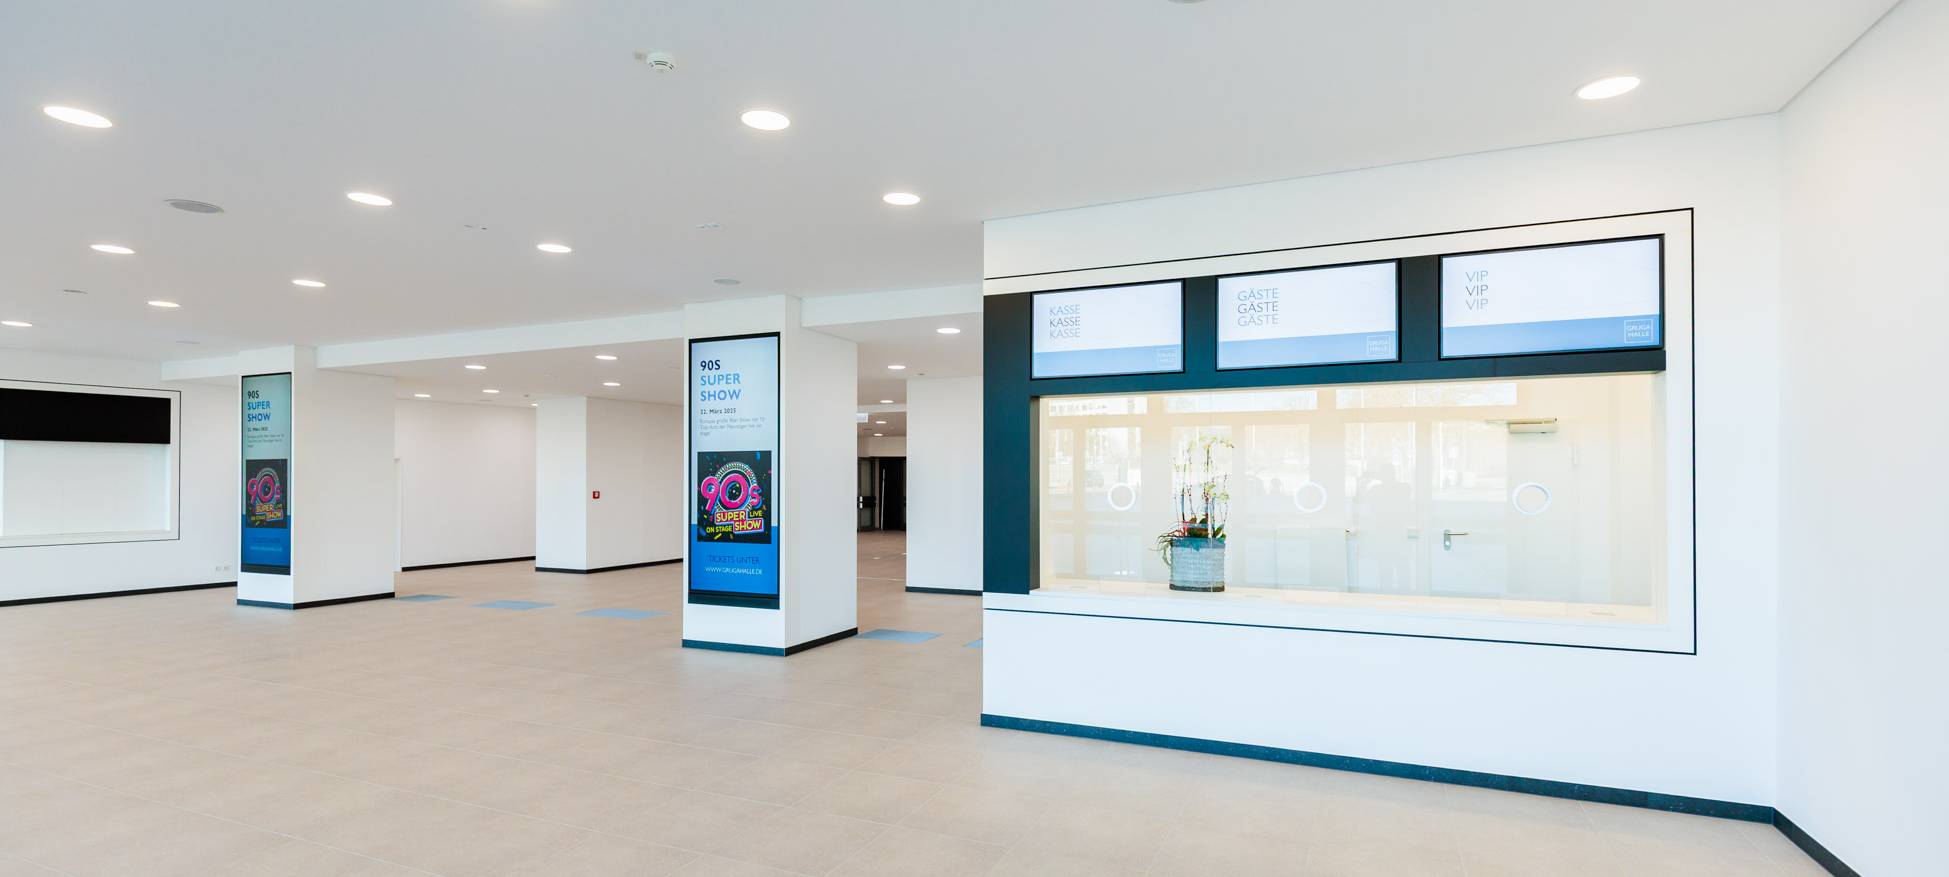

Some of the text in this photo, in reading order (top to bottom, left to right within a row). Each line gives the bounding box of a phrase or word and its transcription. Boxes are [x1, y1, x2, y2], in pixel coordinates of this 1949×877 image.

[1465, 270, 1489, 282] VIP
[1237, 287, 1279, 301] GÄSTE
[1465, 285, 1489, 296] VIP
[1049, 304, 1080, 316] KASSE
[1237, 301, 1279, 314] GÄSTE
[1465, 298, 1489, 310] VIP
[1049, 316, 1080, 327] KASSE
[1237, 313, 1279, 327] GÄSTE
[1049, 327, 1080, 339] KASSE
[700, 359, 720, 371] 90S
[700, 373, 741, 386] SUPER
[247, 390, 260, 399] 90S
[700, 389, 741, 402] SHOW
[247, 400, 271, 410] SUPER
[247, 412, 271, 422] SHOW
[715, 511, 746, 522] SUPER
[749, 510, 763, 518] LIVE
[715, 524, 732, 533] STAGE
[734, 519, 761, 531] SHOW
